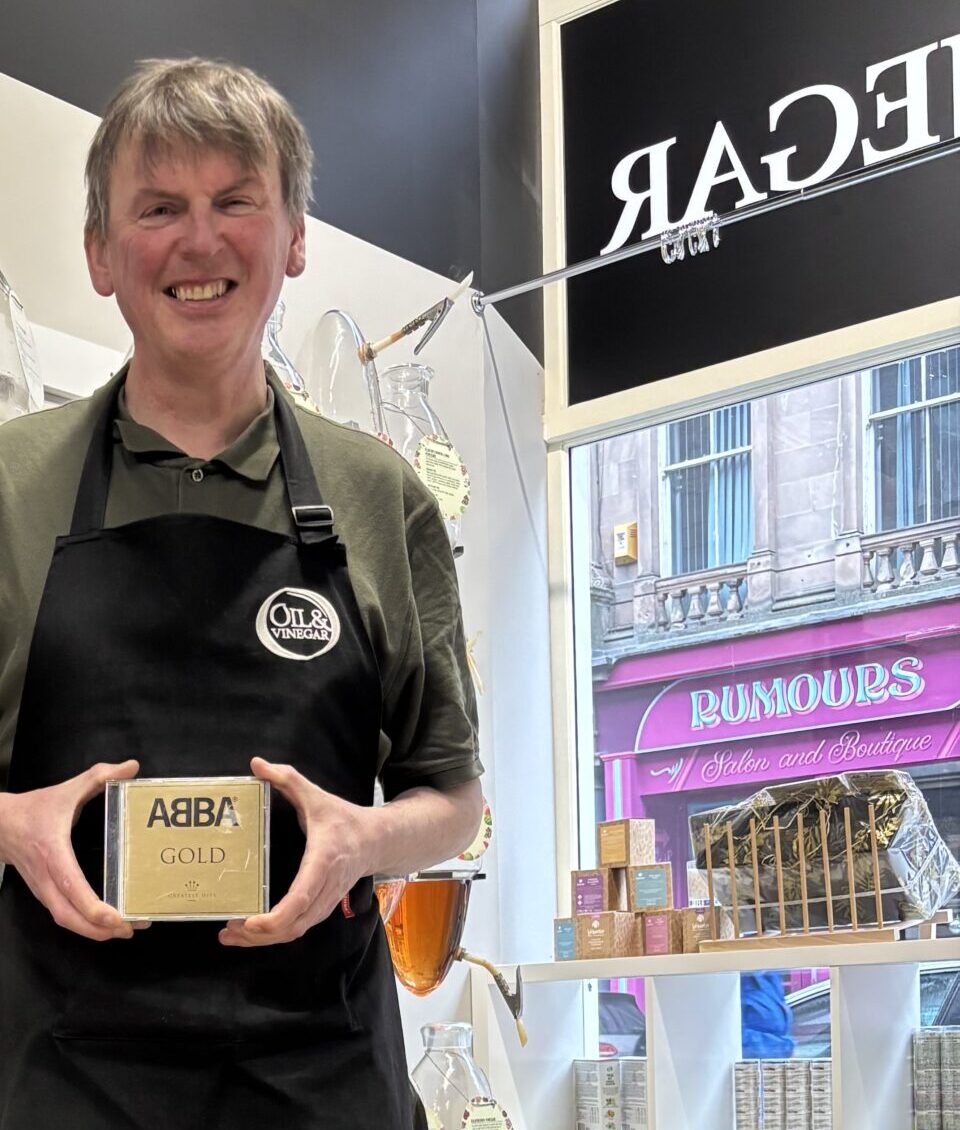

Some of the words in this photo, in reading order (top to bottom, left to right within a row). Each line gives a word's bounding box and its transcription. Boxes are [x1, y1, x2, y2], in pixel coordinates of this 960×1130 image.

[271, 628, 330, 640] VINEGAR
[690, 656, 925, 730] RUMOURS
[702, 750, 770, 783] Salon
[779, 740, 824, 768] and
[828, 730, 933, 764] Boutique
[146, 796, 240, 828] ABBA
[160, 848, 226, 864] GOLD
